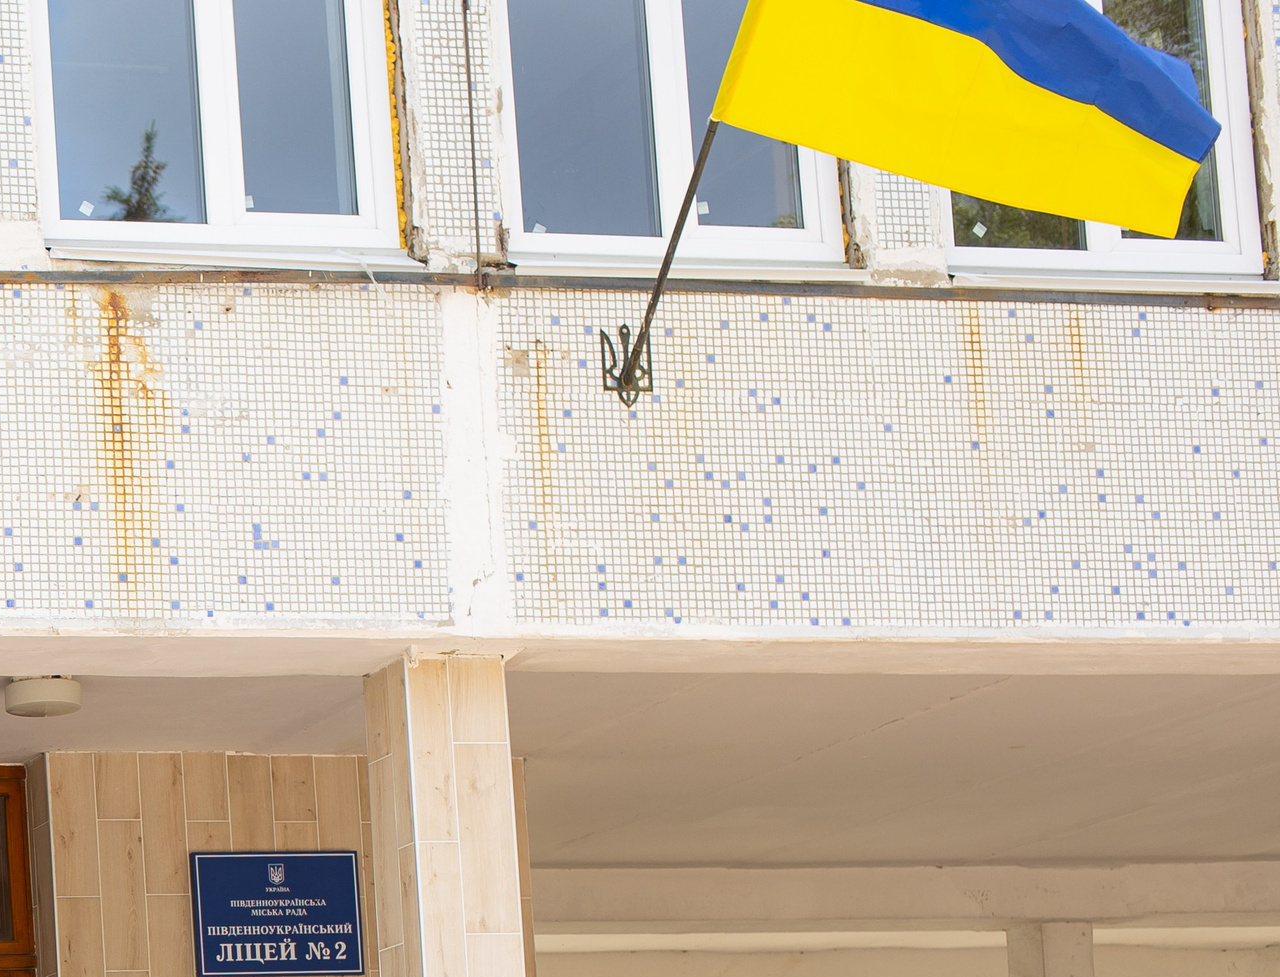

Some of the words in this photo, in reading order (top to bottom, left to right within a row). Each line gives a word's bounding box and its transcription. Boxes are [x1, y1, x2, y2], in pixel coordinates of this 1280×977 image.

[230, 898, 327, 908] ПІВДЕННОУКРАЇНСЬКА
[251, 908, 284, 917] МІСЬКА
[285, 908, 308, 917] РАДА
[207, 922, 353, 937] ПІВДЕННОУКРАЇНСЬКИЙ
[216, 938, 298, 965] ЛІЦЕЙ
